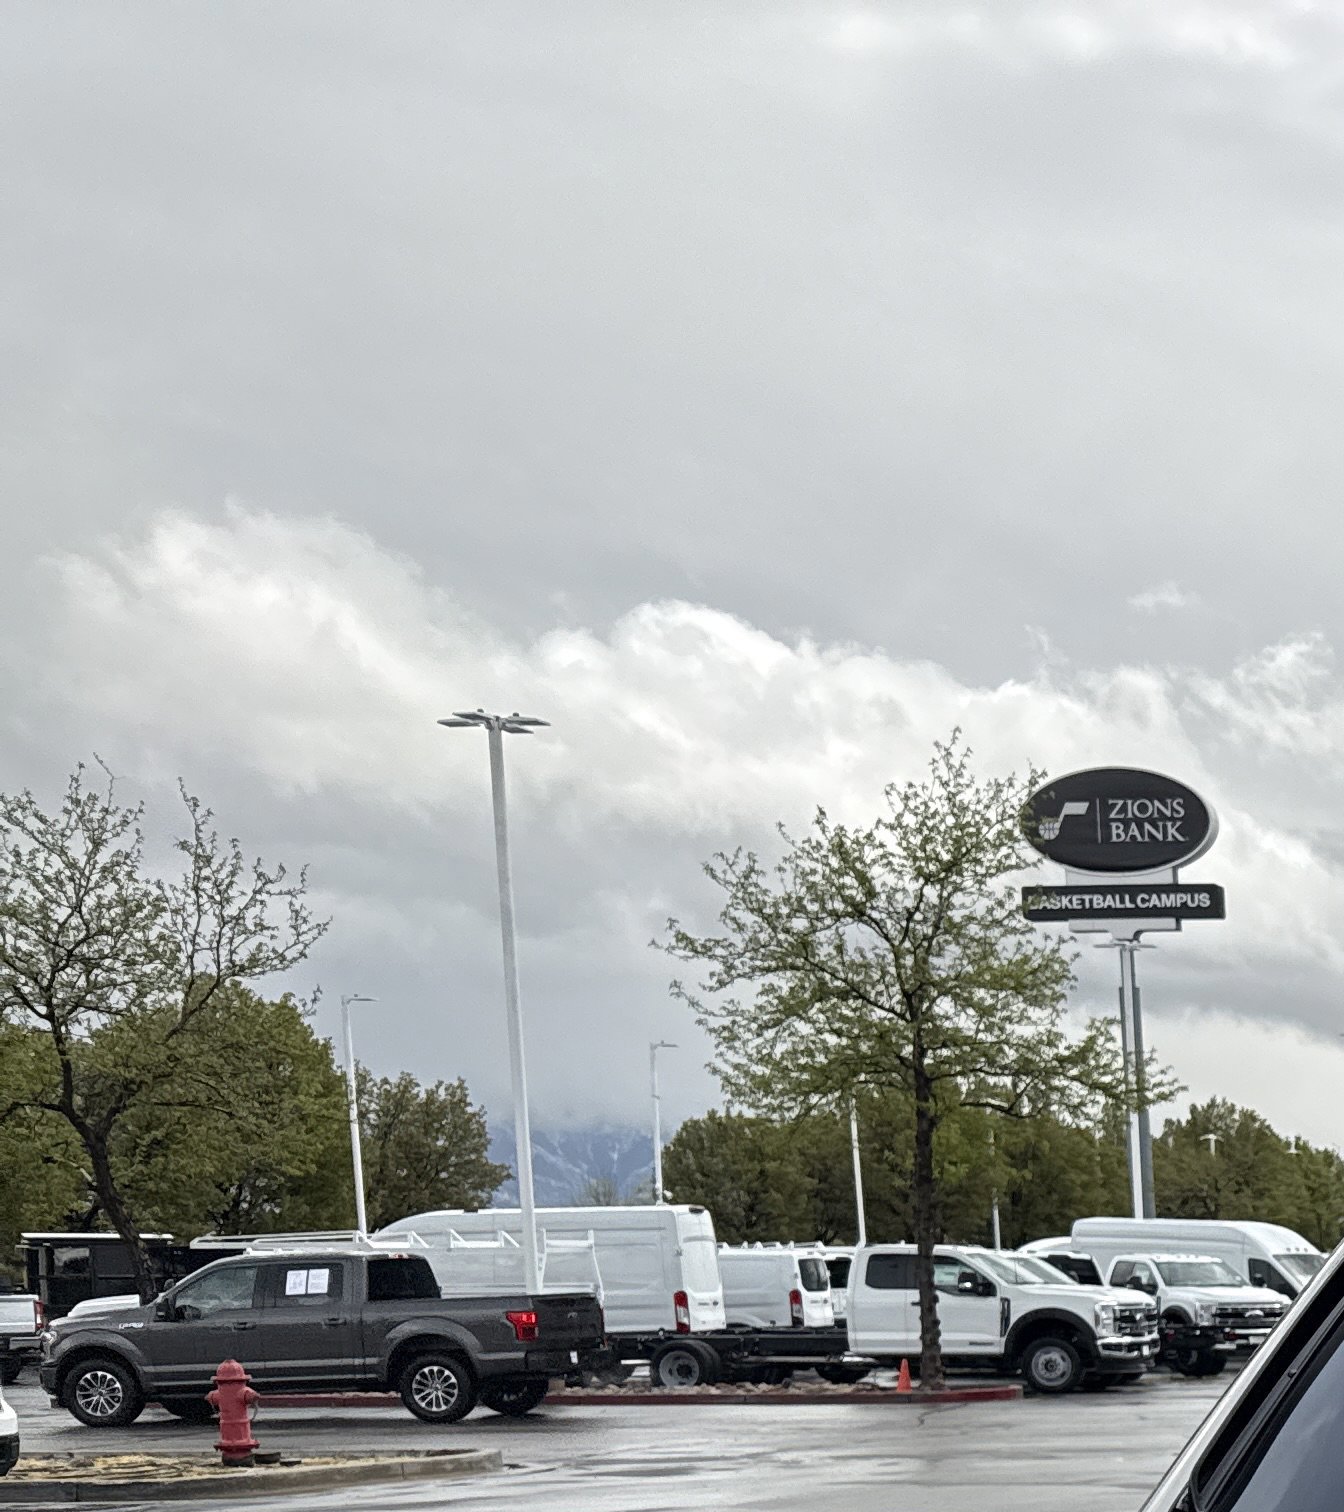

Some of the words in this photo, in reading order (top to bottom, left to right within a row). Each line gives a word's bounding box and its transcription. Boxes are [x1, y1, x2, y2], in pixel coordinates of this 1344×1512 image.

[1108, 798, 1185, 819] ZIONS
[1109, 821, 1186, 842] BANK
[1136, 893, 1211, 909] CAMPUS
